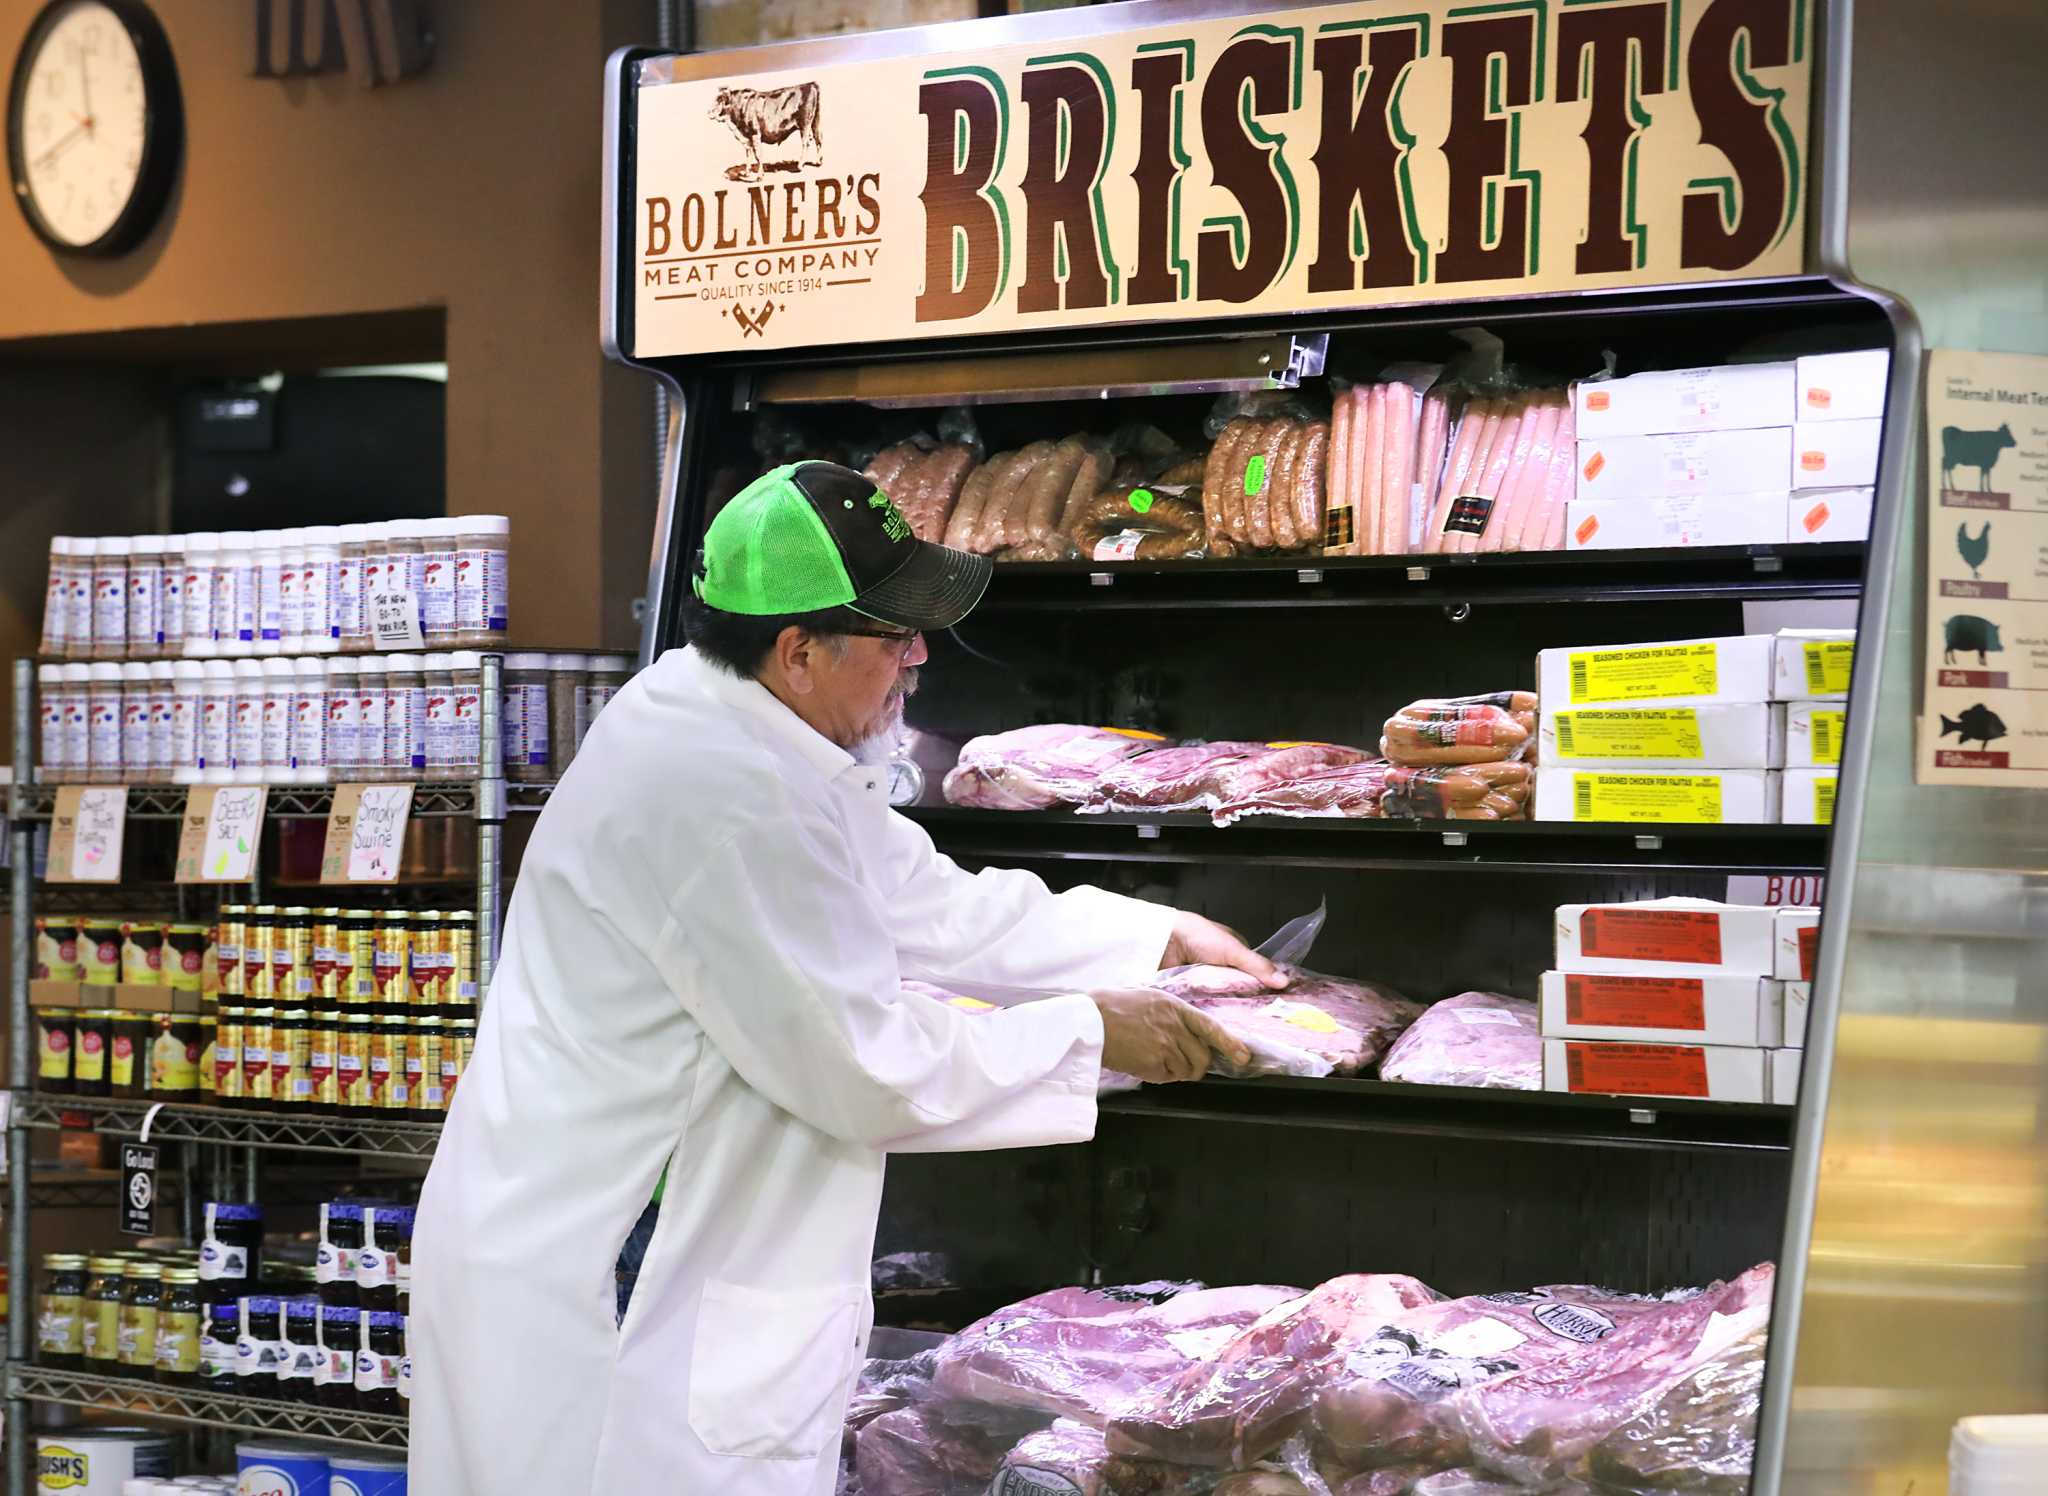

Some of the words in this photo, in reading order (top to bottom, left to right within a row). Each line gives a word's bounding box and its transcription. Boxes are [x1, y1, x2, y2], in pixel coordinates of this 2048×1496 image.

[915, 0, 1805, 323] BRISKETS
[645, 173, 881, 256] BOLNER'S
[644, 263, 718, 287] MEAT
[735, 247, 880, 279] COMPANY
[700, 283, 753, 301] QUALITY
[758, 279, 793, 296] SINCE
[798, 277, 822, 292] 1914
[1946, 386, 1994, 402] Internal
[1997, 389, 2028, 405] Meat
[218, 823, 239, 839] SALT
[354, 823, 392, 849] Swine
[126, 1149, 137, 1168] Go
